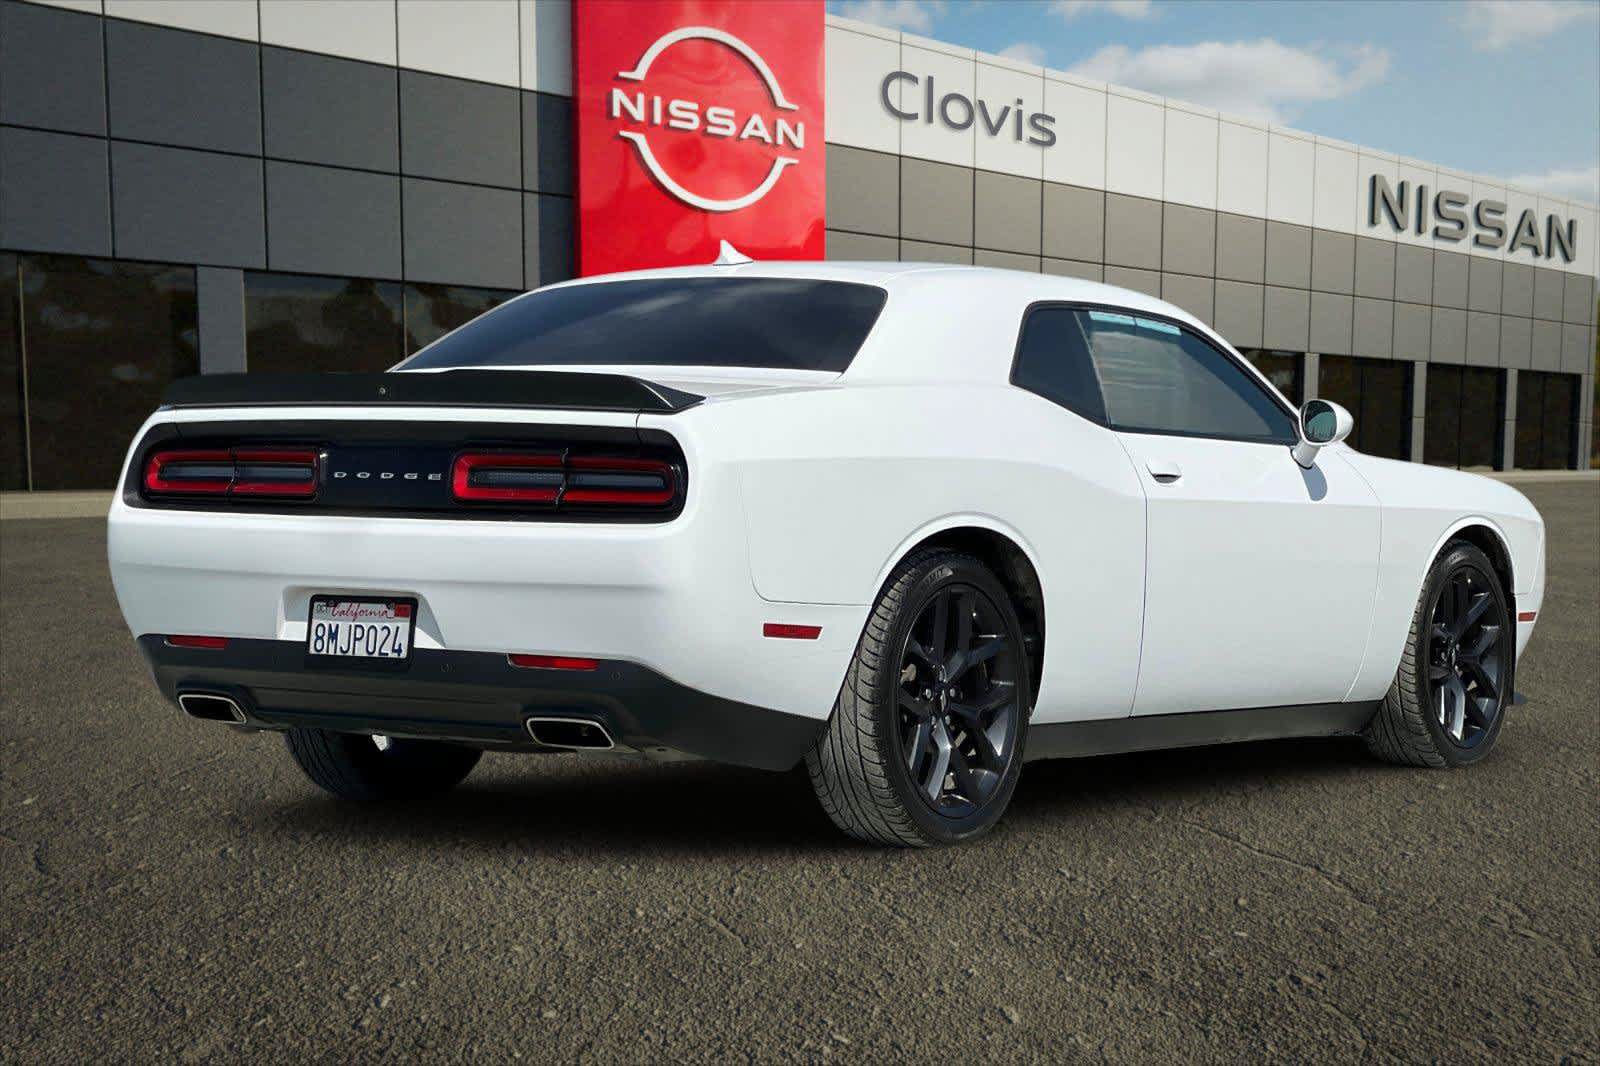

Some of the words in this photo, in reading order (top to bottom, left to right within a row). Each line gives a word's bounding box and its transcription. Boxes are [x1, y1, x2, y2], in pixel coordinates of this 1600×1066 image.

[611, 87, 805, 149] NISSAN
[880, 71, 1057, 147] Clovis
[1368, 174, 1577, 263] NISSAN
[333, 471, 441, 481] DODGE
[331, 602, 392, 622] California
[313, 623, 403, 656] 8MJP024
